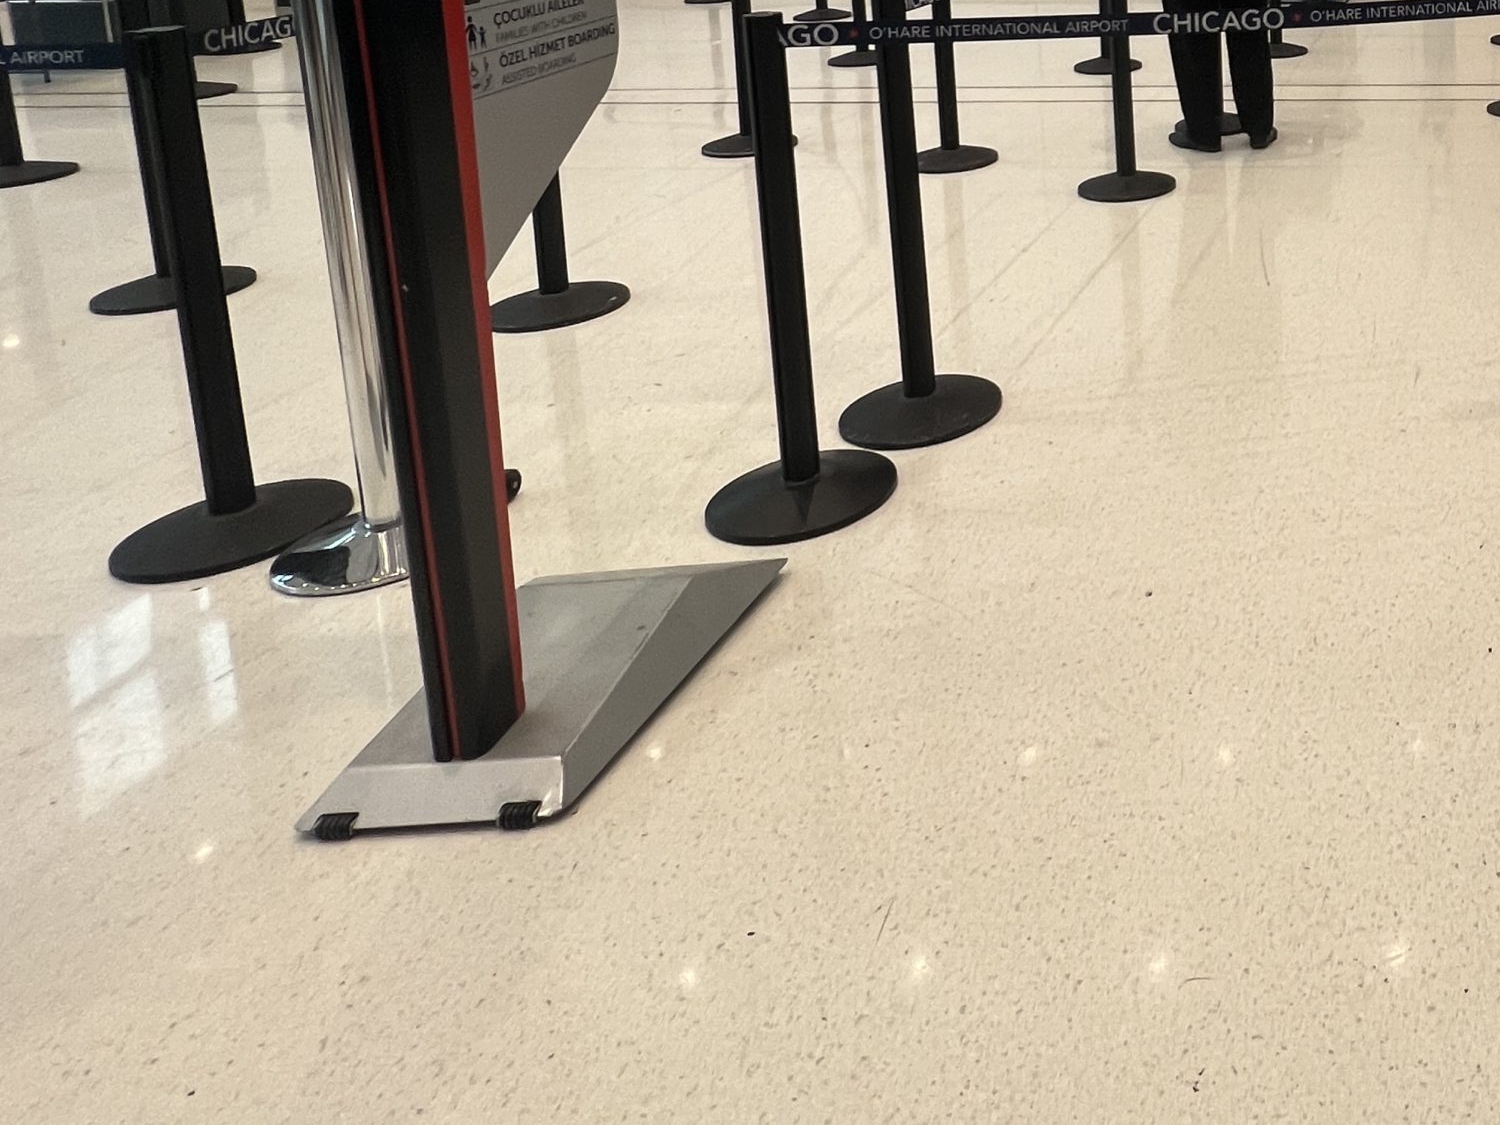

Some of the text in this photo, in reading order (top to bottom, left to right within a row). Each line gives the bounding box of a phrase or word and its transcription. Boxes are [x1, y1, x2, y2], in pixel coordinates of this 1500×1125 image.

[204, 16, 295, 52] CHICAG
[869, 24, 931, 40] O'HARE
[935, 21, 1059, 37] INTERNATIONAL
[1065, 18, 1129, 33] AIRPORT
[1153, 8, 1285, 35] CHICAGO
[1310, 8, 1363, 22] O'HARE
[1366, 1, 1473, 20] INTERNATIONAL
[10, 50, 84, 65] AIRPORT
[500, 49, 526, 67] ÖZEL
[568, 23, 615, 47] BOARDING
